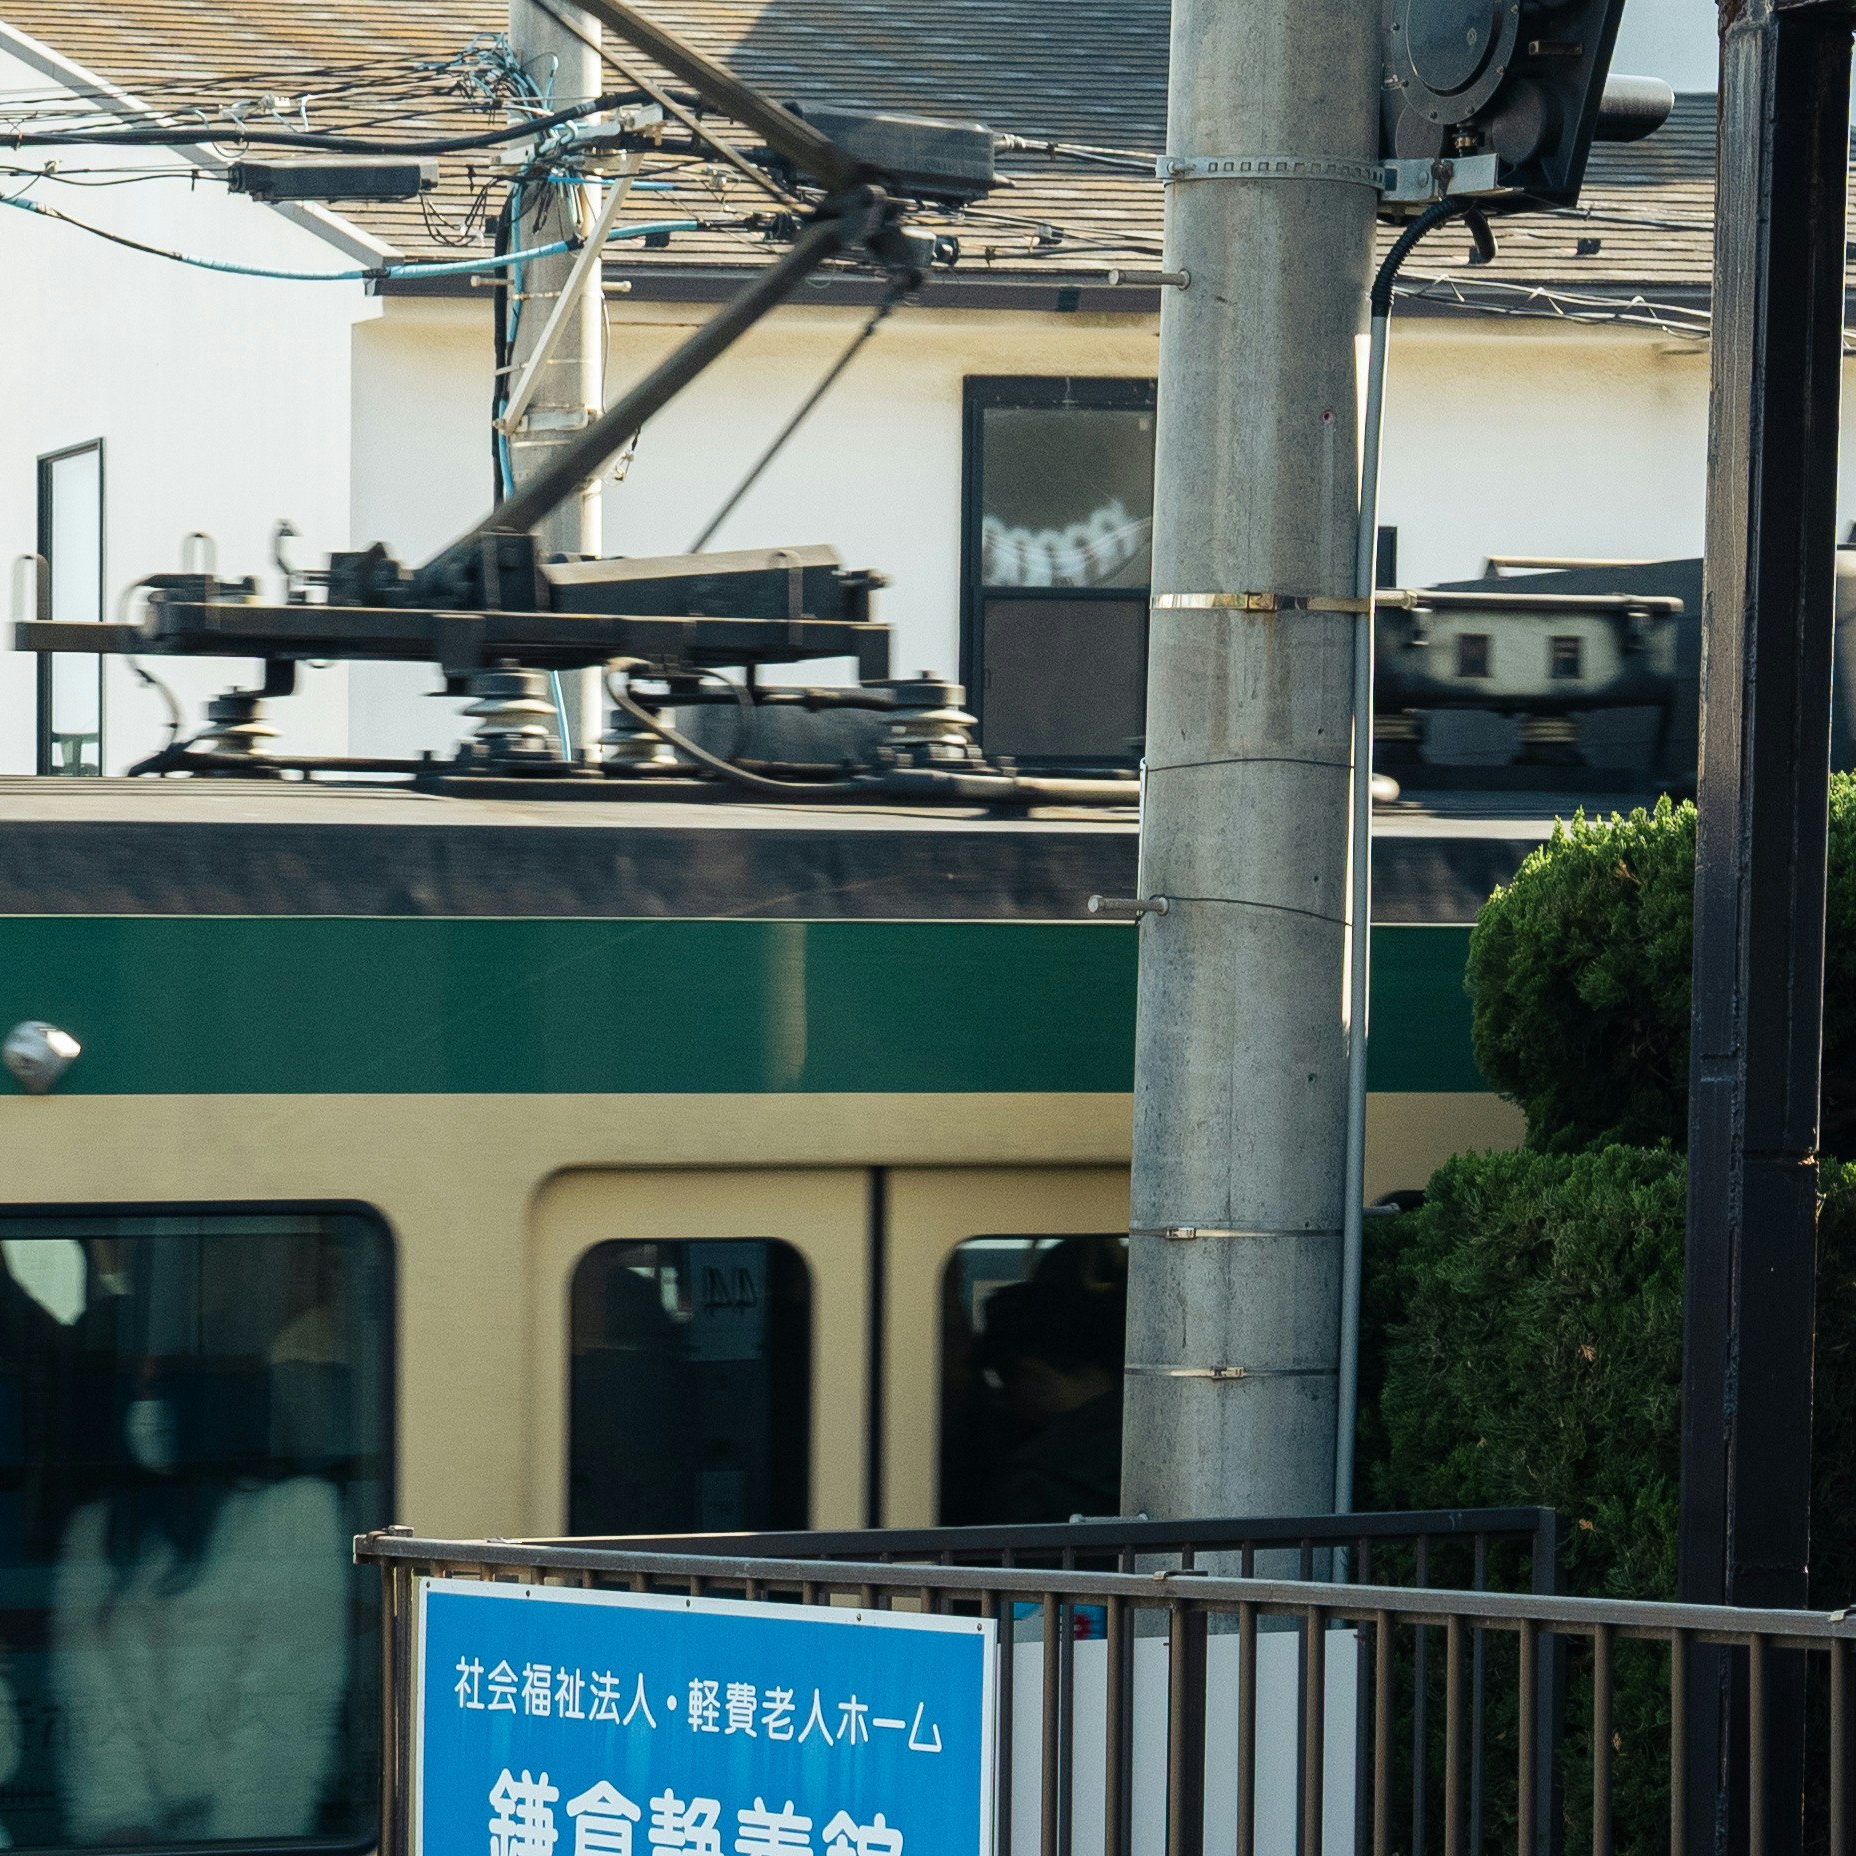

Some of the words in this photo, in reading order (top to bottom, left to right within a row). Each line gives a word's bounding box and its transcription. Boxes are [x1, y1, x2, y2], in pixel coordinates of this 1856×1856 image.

[454, 1655, 943, 1754] 社会福祉法人・軽費老人ホーム
